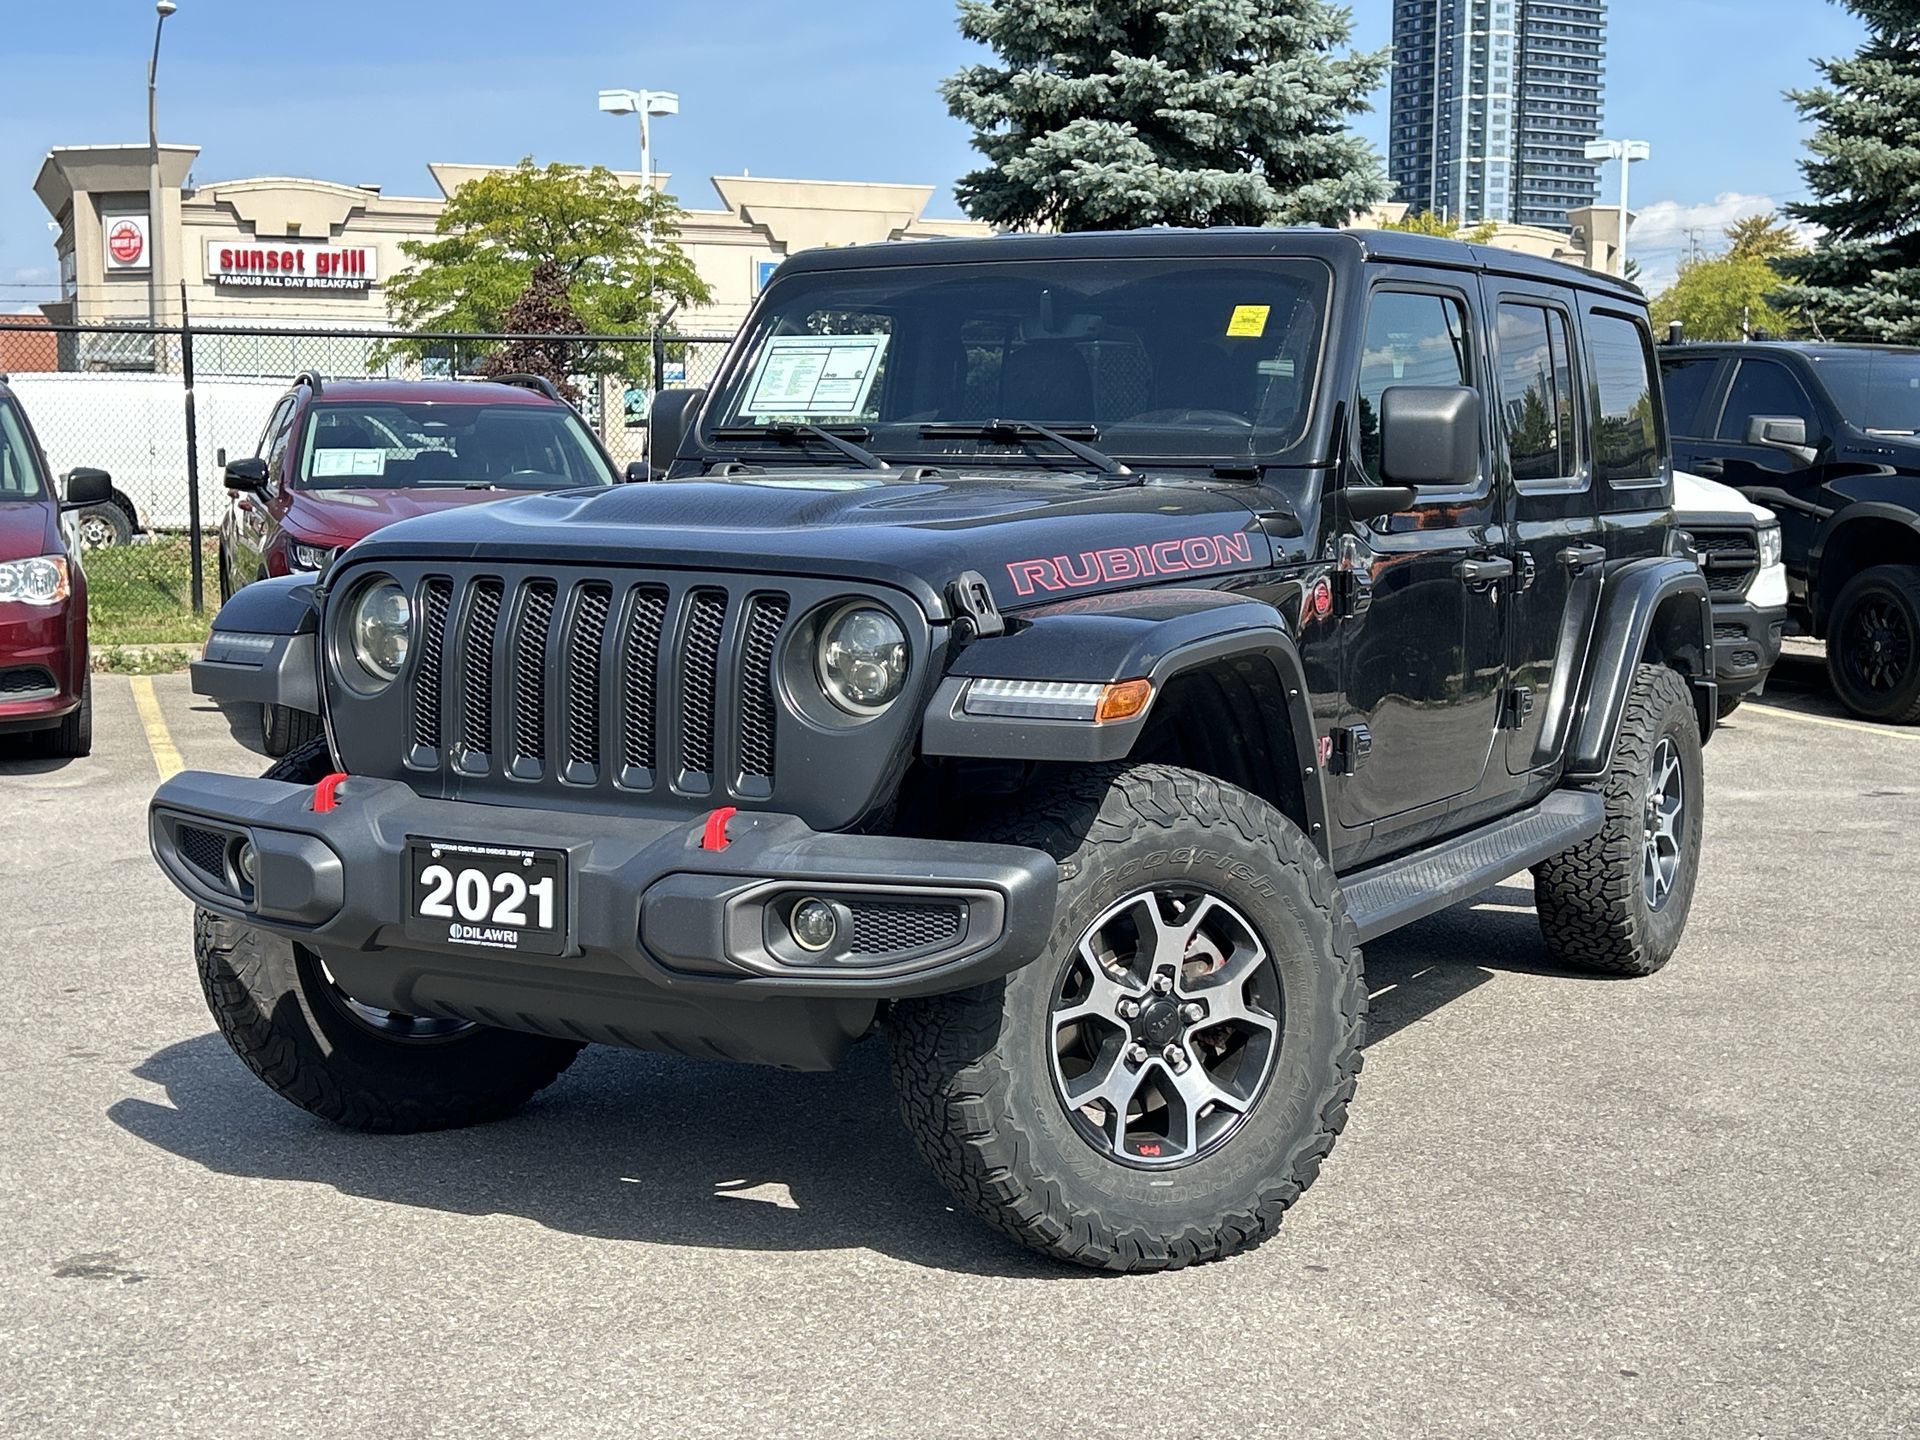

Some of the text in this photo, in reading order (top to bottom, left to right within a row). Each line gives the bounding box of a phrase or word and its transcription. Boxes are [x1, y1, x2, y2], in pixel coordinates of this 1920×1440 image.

[220, 248, 365, 274] sunset grill
[219, 276, 366, 289] FAMOUS ALL DAY BREAKFAST
[1006, 531, 1252, 596] RUBICON
[419, 864, 553, 929] 2021
[463, 925, 518, 943] DILAWRI
